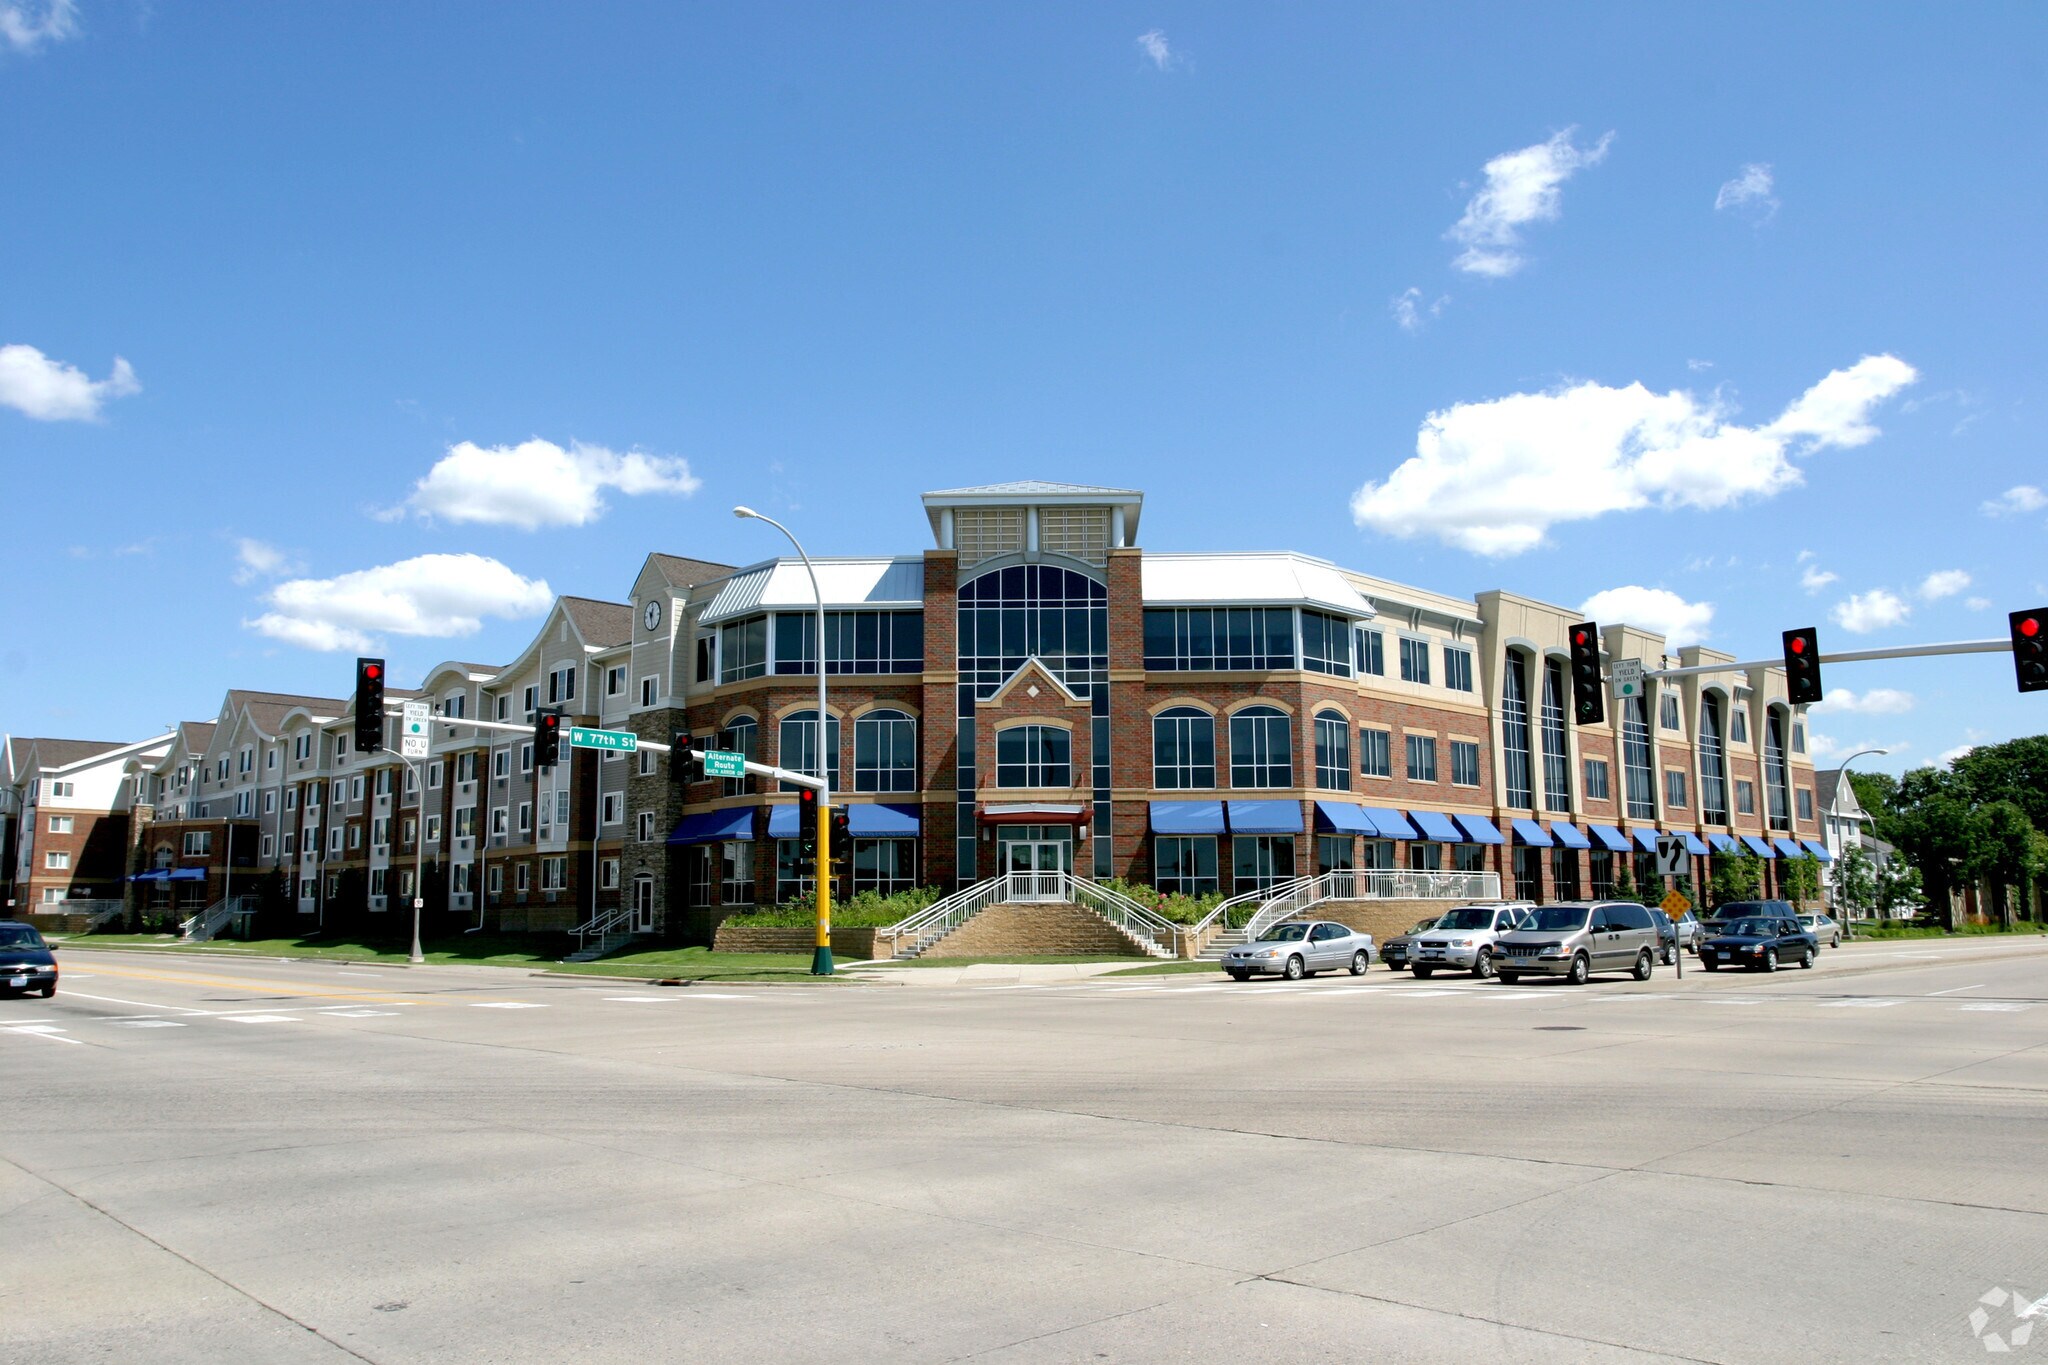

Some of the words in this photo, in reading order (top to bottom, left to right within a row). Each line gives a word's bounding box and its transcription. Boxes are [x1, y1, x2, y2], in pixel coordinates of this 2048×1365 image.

[405, 739, 416, 747] NO
[574, 732, 583, 742] W
[589, 734, 615, 745] 77th
[622, 737, 634, 747] St
[708, 753, 742, 762] Alternate
[714, 761, 735, 769] Route
